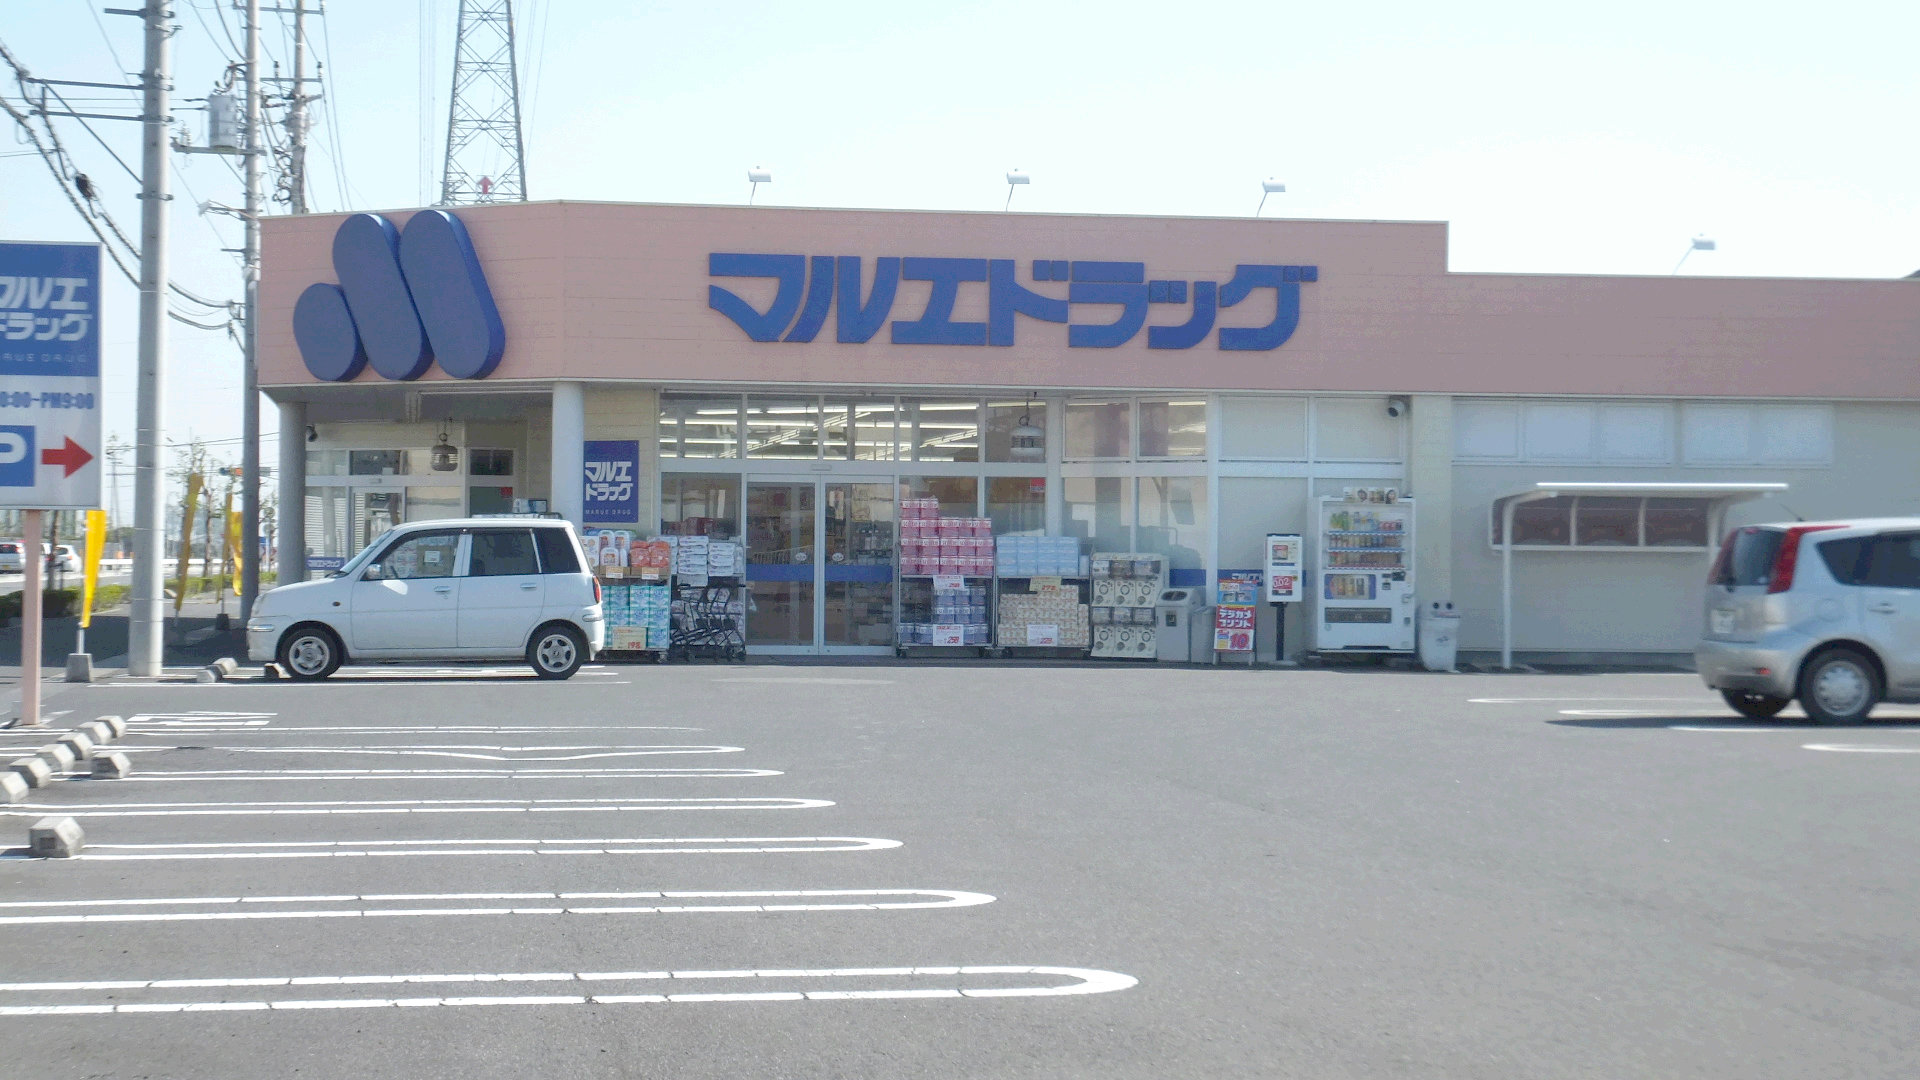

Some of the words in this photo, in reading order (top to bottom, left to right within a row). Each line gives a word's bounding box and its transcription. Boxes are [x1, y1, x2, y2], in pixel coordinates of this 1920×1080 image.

[709, 252, 1318, 352] マルエドラッグ
[585, 461, 632, 482] マルエ
[585, 483, 633, 501] ドラッグ
[1219, 609, 1252, 619] デジカメ
[1218, 619, 1251, 628] プリント
